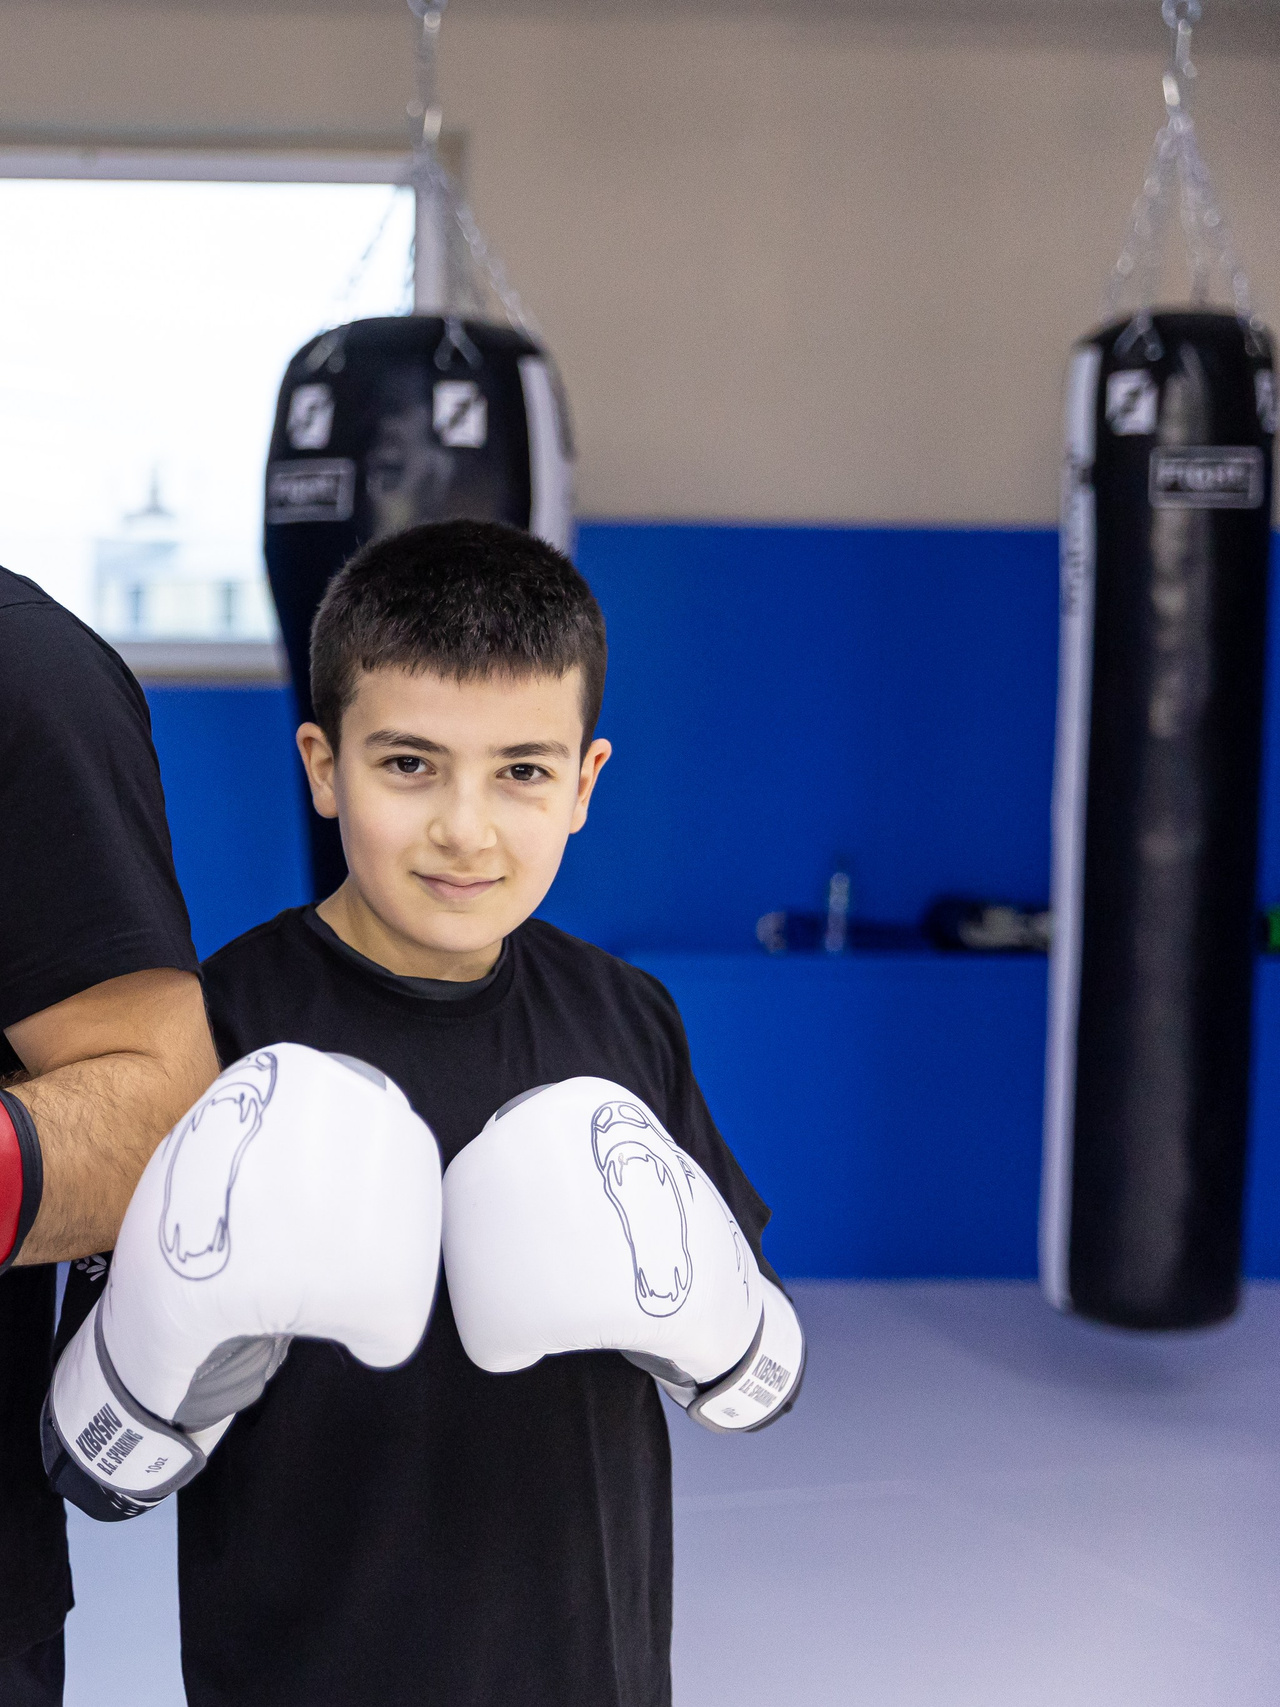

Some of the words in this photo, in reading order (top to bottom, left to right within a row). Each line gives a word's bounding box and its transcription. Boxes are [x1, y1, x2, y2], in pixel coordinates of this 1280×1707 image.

[751, 1353, 791, 1393] KIBOSHU
[75, 1402, 123, 1462] KIBOSHU
[97, 1457, 118, 1476] B.G.
[109, 1428, 144, 1466] SPARRING
[145, 1456, 169, 1474] 10oz
